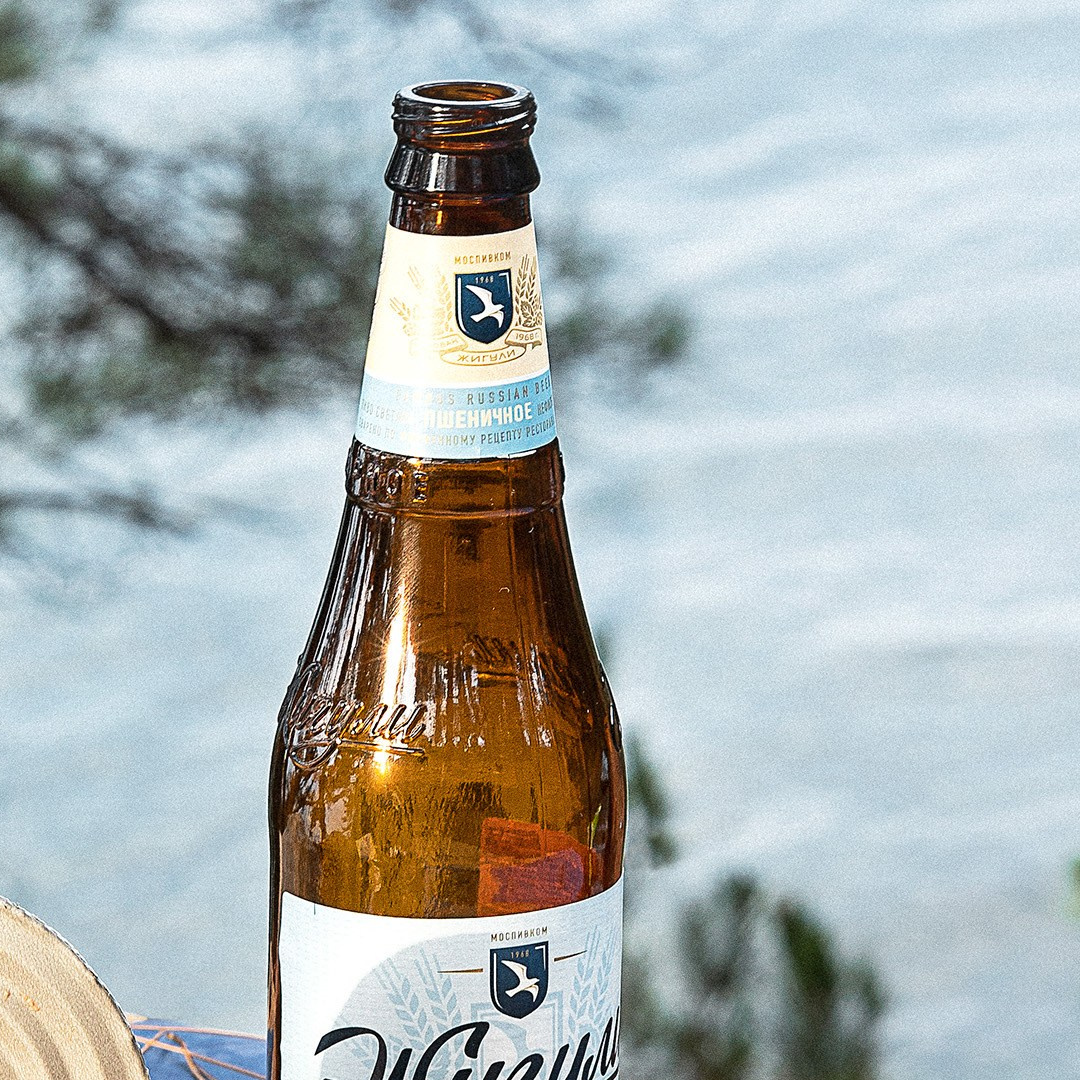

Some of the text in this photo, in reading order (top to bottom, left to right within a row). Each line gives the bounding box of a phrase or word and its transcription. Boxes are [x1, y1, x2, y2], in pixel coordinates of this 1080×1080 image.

[454, 251, 511, 265] МОСПИВКОМ
[475, 276, 494, 284] 1968
[467, 385, 528, 405] RUSSIAN
[425, 401, 533, 430] ПШЕНИЧНОЕ
[480, 429, 522, 445] РЕЦЕПТУ
[490, 926, 548, 943] МОСПИВКОМ
[510, 949, 530, 959] 1968
